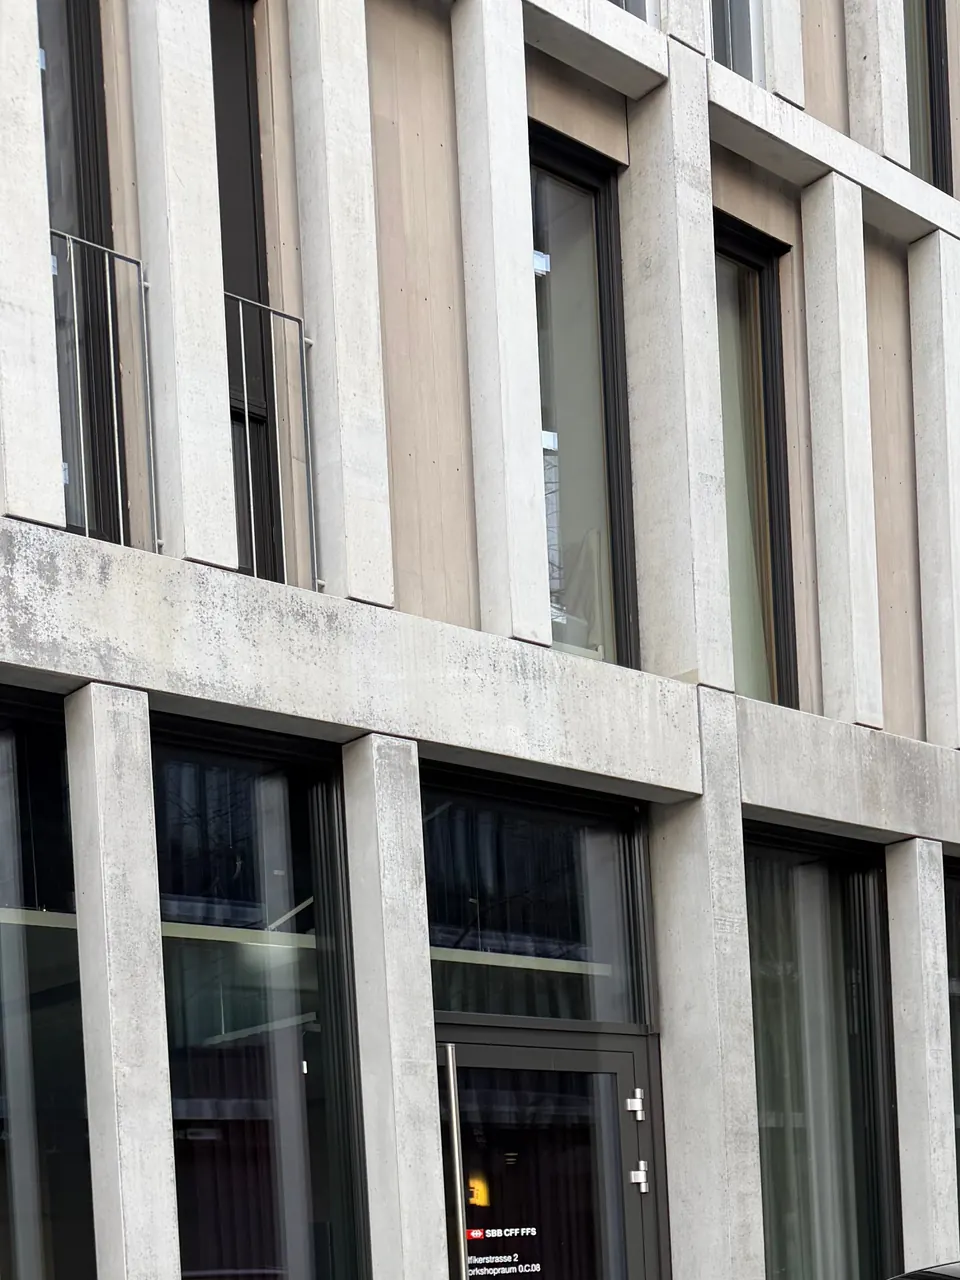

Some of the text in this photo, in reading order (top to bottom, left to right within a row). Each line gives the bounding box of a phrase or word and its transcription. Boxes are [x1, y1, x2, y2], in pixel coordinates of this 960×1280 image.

[485, 1227, 537, 1238] SBB CFF FFS
[513, 1253, 519, 1262] 2
[468, 1266, 517, 1276] orkshopraum
